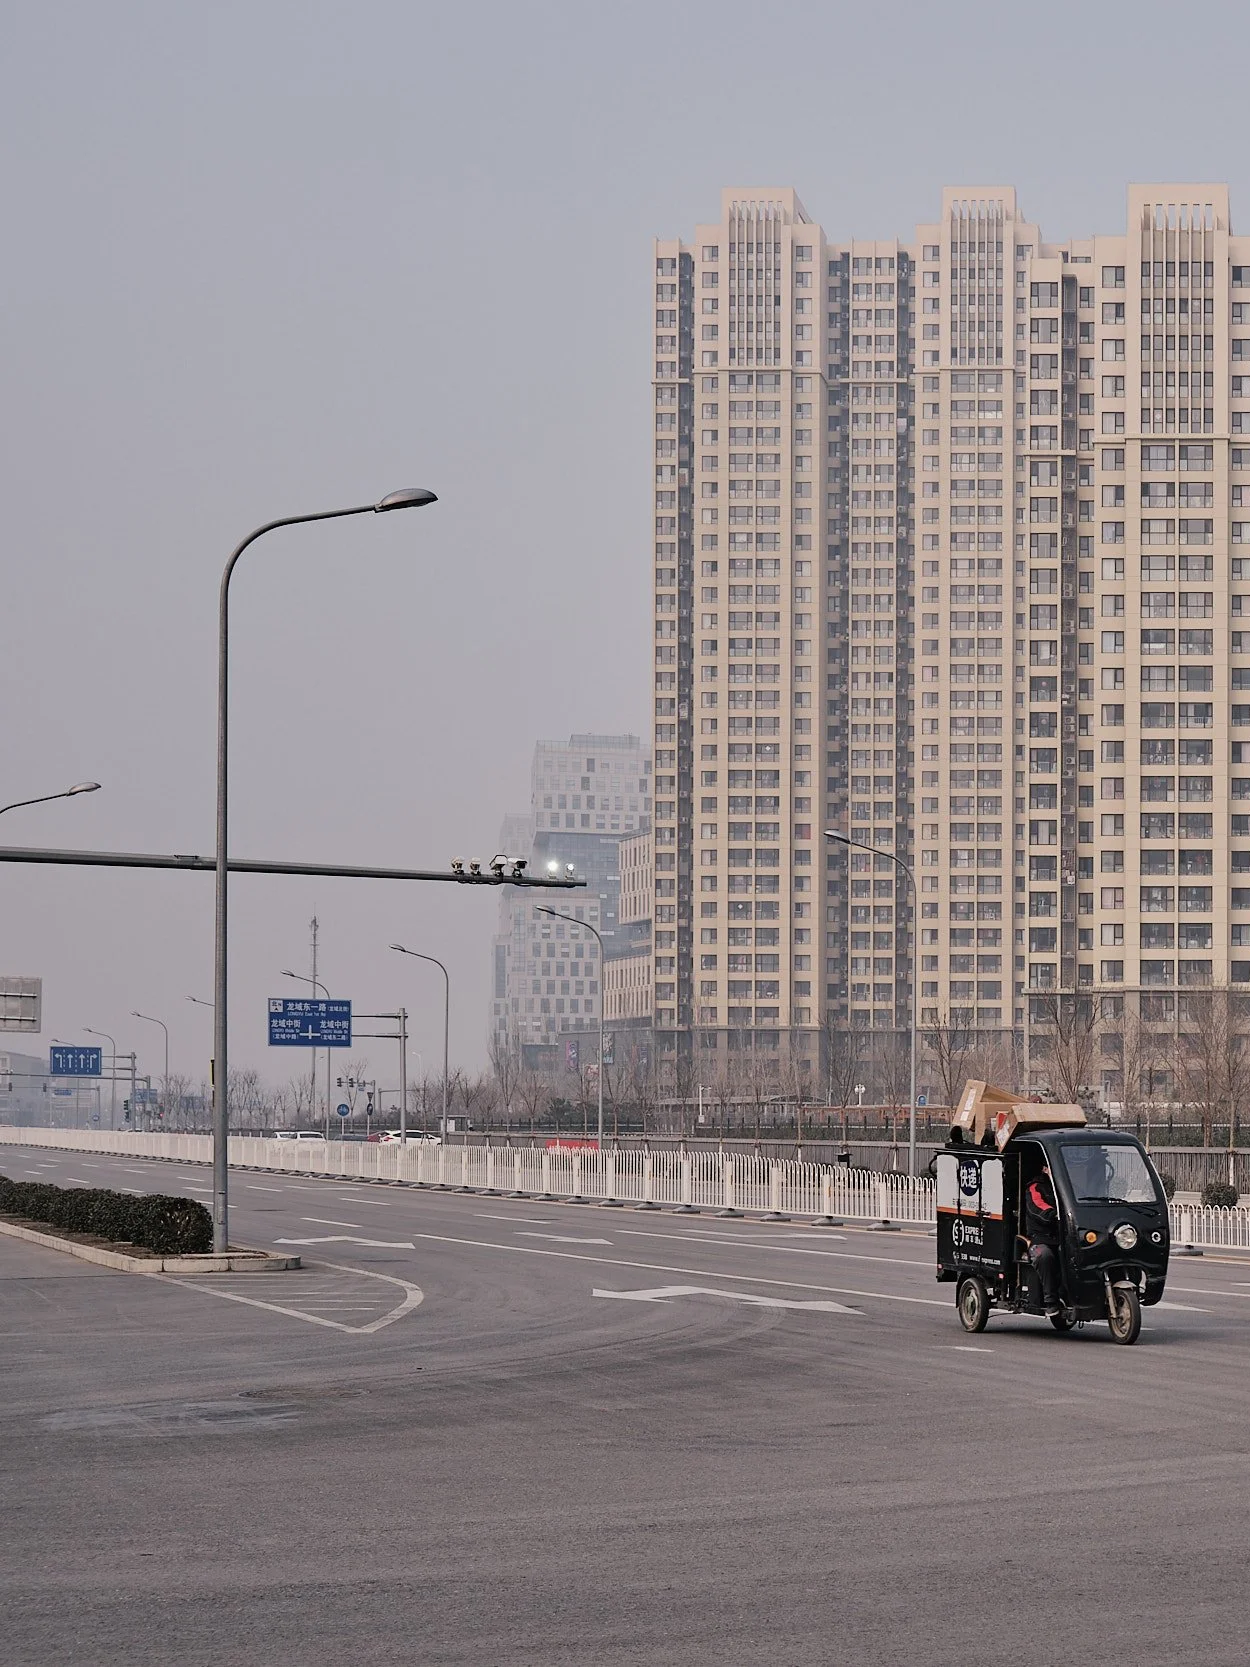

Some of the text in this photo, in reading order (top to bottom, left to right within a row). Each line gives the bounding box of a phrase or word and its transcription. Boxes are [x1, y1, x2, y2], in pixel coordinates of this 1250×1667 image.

[286, 1002, 326, 1012] 龙域东一路
[270, 1019, 300, 1028] 龙域中街
[320, 1020, 349, 1029] 龙域中街
[960, 1165, 977, 1189] 快递
